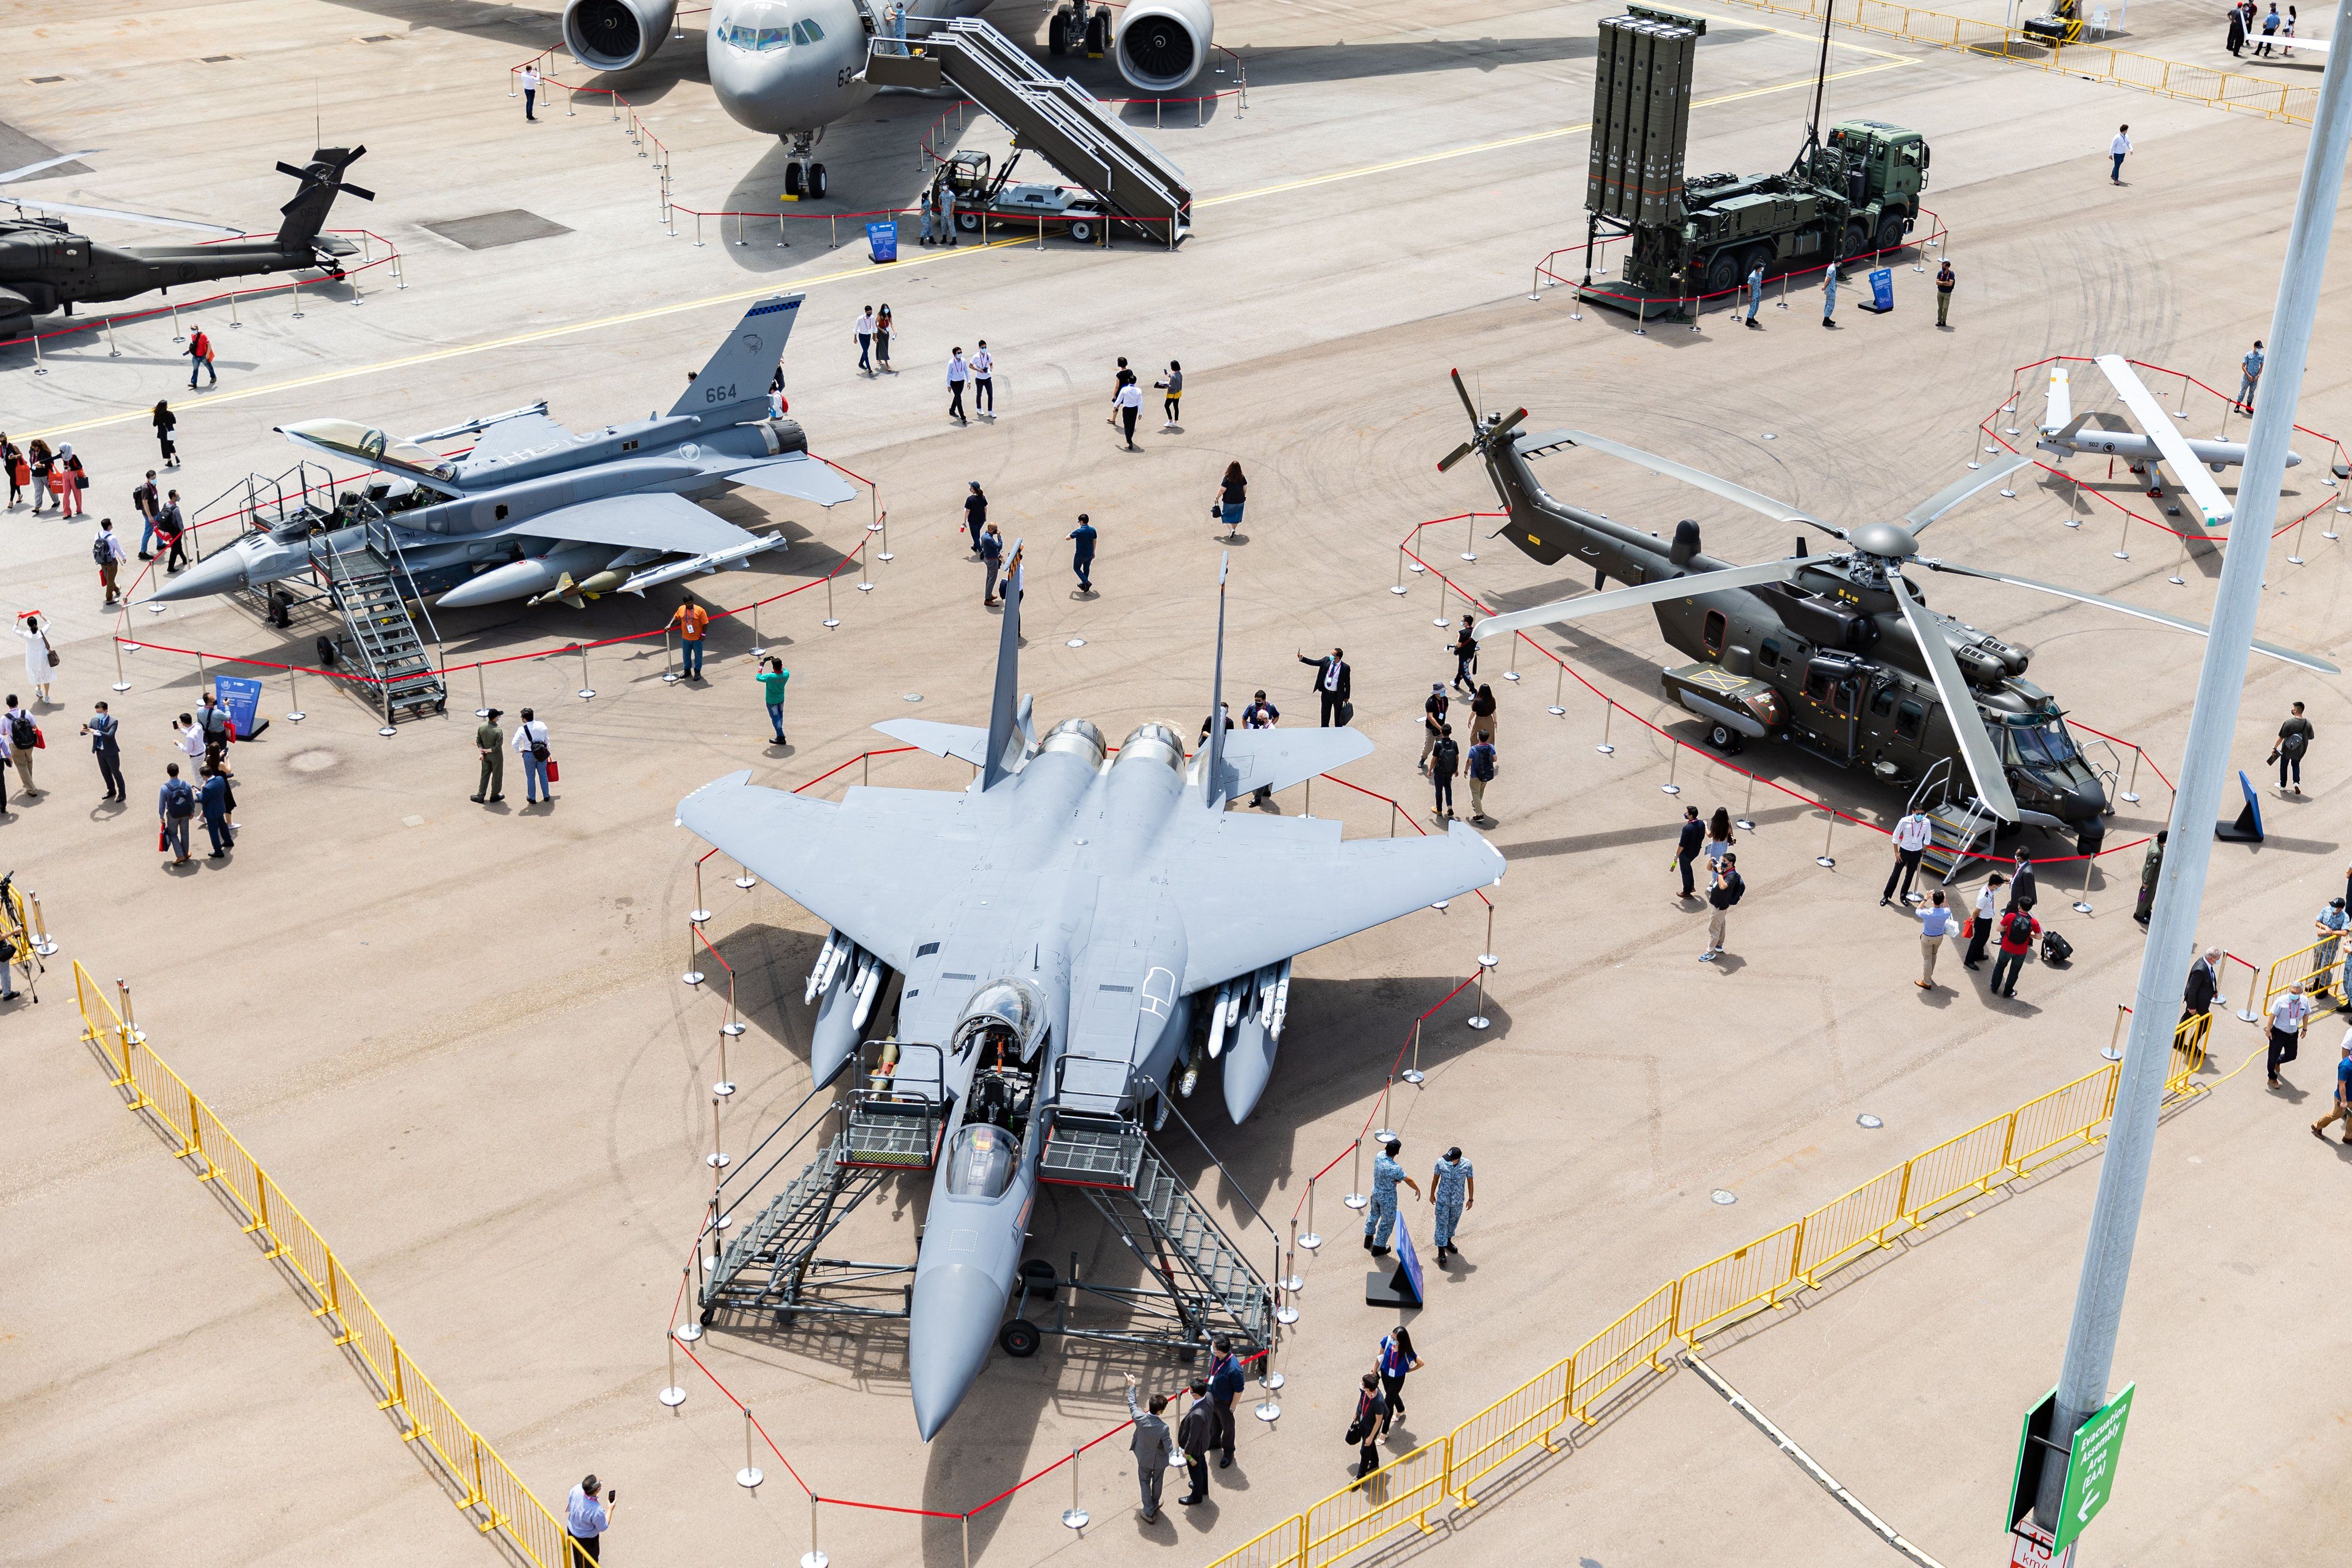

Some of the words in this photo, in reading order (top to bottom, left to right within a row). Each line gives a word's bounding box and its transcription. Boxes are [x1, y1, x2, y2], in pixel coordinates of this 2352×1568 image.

[838, 66, 851, 88] 63
[706, 384, 737, 403] 664
[2081, 1404, 2127, 1452] Evacuation
[2080, 1422, 2121, 1466] Assembly
[2087, 1449, 2107, 1474] Area
[2082, 1459, 2106, 1495] (EAA)
[2022, 1552, 2048, 1568] km/
[2029, 1532, 2052, 1561] 15
